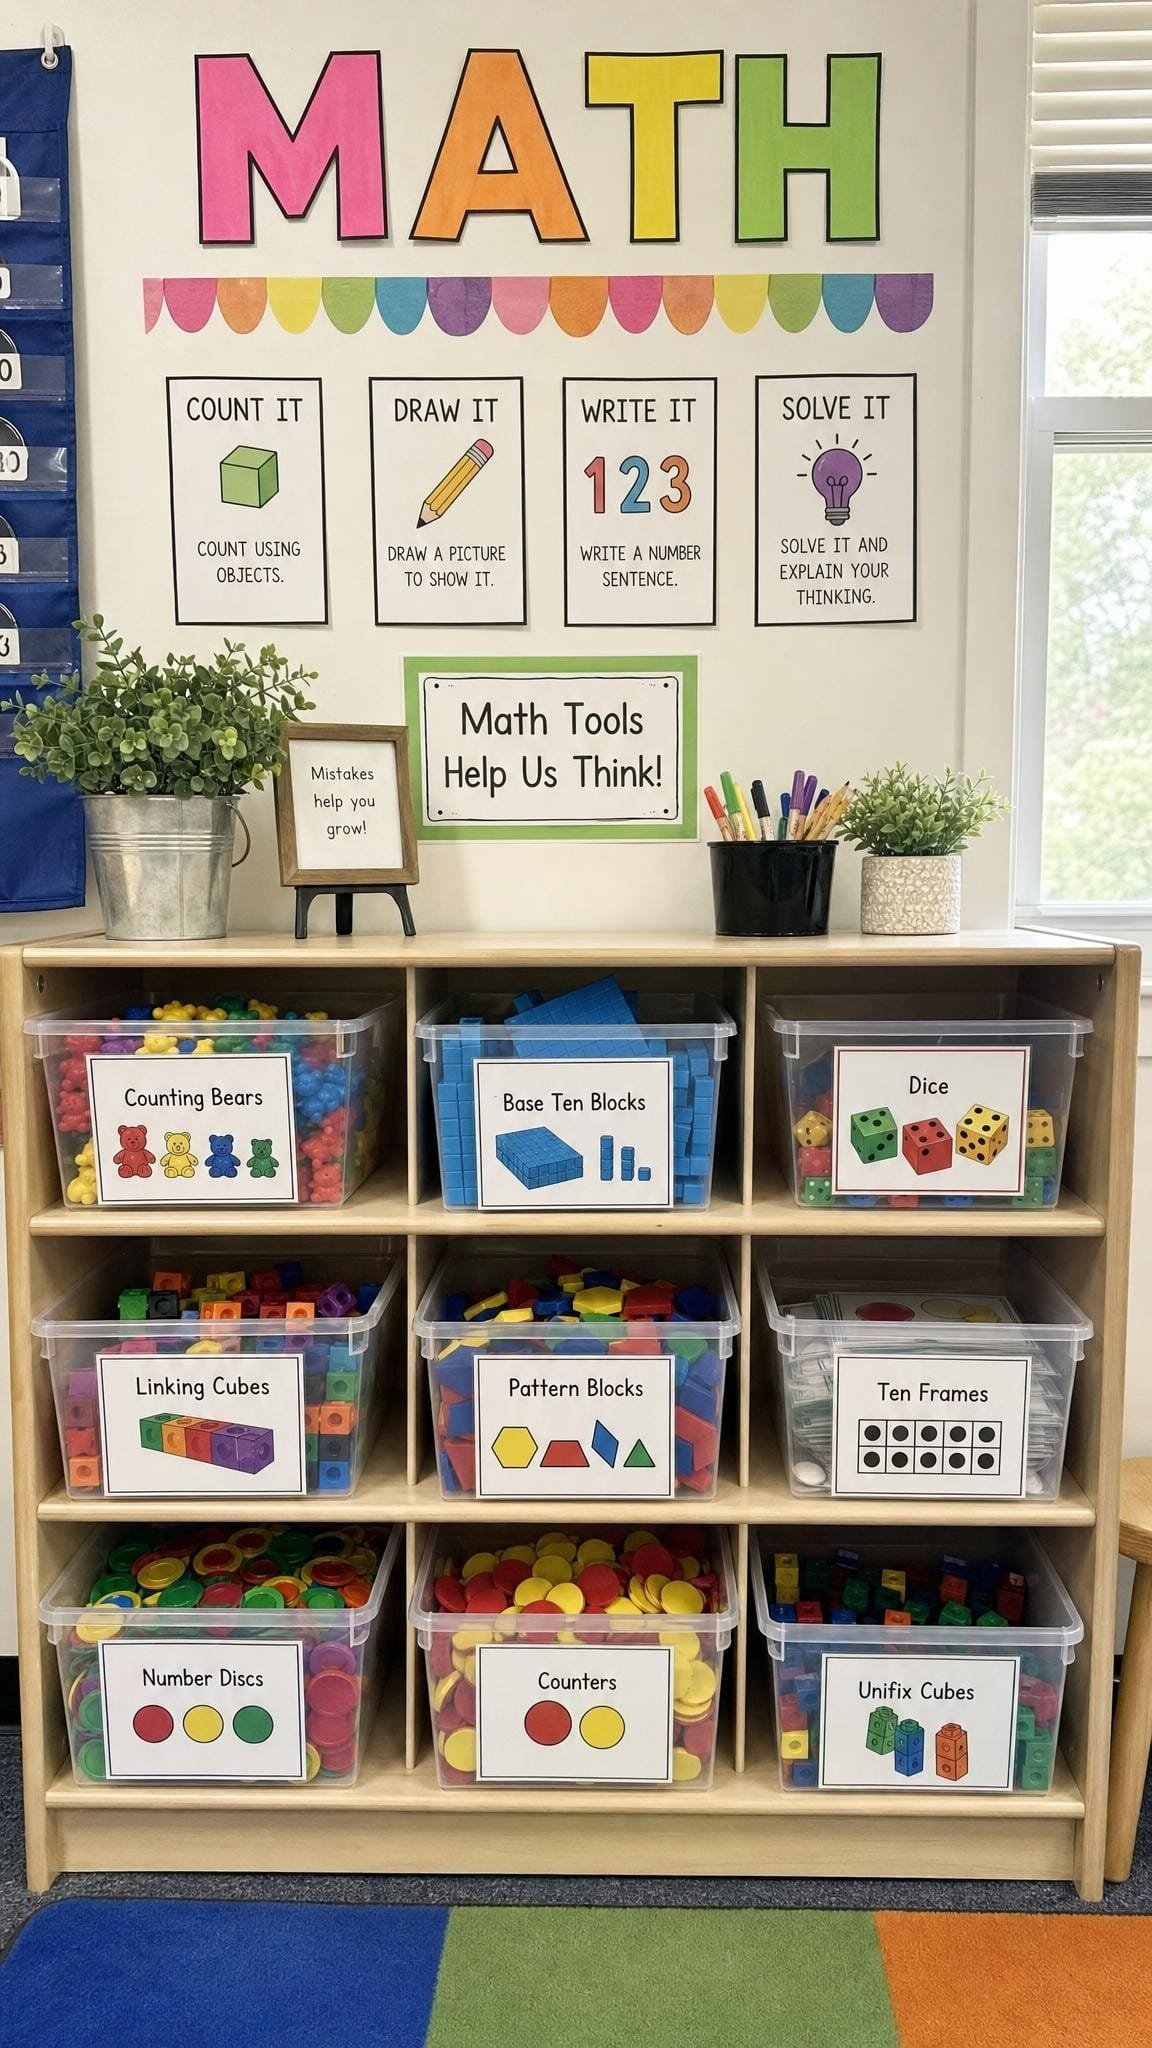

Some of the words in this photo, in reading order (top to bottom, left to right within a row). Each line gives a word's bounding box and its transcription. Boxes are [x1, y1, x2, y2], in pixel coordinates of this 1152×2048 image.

[194, 48, 882, 244] MATH
[186, 396, 265, 422] COUNT
[276, 397, 303, 423] IT
[394, 398, 461, 423] DRAW
[472, 398, 499, 423] IT
[581, 398, 657, 423] WRITE
[669, 398, 697, 423] IT
[782, 395, 851, 421] SOLVE
[863, 395, 891, 420] IT
[197, 540, 248, 557] COUNT
[254, 540, 301, 557] USING
[387, 545, 428, 562] DRAW
[433, 546, 444, 562] A
[449, 545, 506, 562] PICTURE
[579, 545, 626, 562] WRITE
[632, 545, 643, 561] A
[648, 544, 701, 561] NUMBER
[780, 537, 826, 555] SOLVE
[833, 537, 851, 553] IT
[858, 536, 888, 553] AND
[216, 566, 284, 583] OBJECTS.
[404, 571, 423, 587] TO
[429, 571, 469, 587] SHOW
[475, 571, 494, 587] IT.
[602, 570, 678, 587] SENTENCE.
[780, 563, 843, 580] EXPLAIN
[850, 562, 889, 579] YOUR
[796, 588, 876, 606] THINKING.
[461, 701, 548, 736] Math
[563, 701, 644, 735] Tools
[311, 766, 374, 781] Mistakes
[444, 755, 507, 799] Help
[522, 755, 558, 788] Us
[572, 754, 662, 788] Think!
[313, 793, 343, 812] help
[350, 797, 376, 812] you
[326, 820, 366, 840] grow!
[909, 1075, 949, 1095] Dice
[124, 1087, 205, 1112] Counting
[211, 1087, 263, 1106] Bears
[503, 1092, 544, 1112] Base
[550, 1092, 584, 1112] Ten
[591, 1091, 646, 1111] Blocks
[136, 1376, 205, 1401] Linking
[212, 1375, 270, 1395] Cubes
[509, 1377, 580, 1397] Pattern
[587, 1377, 644, 1397] Blocks
[876, 1382, 911, 1402] Ten
[919, 1382, 989, 1403] Frames
[142, 1667, 213, 1687] Number
[220, 1668, 264, 1687] Discs
[538, 1671, 617, 1691] Counters
[858, 1680, 912, 1700] Unifix
[920, 1681, 975, 1701] Cubes
